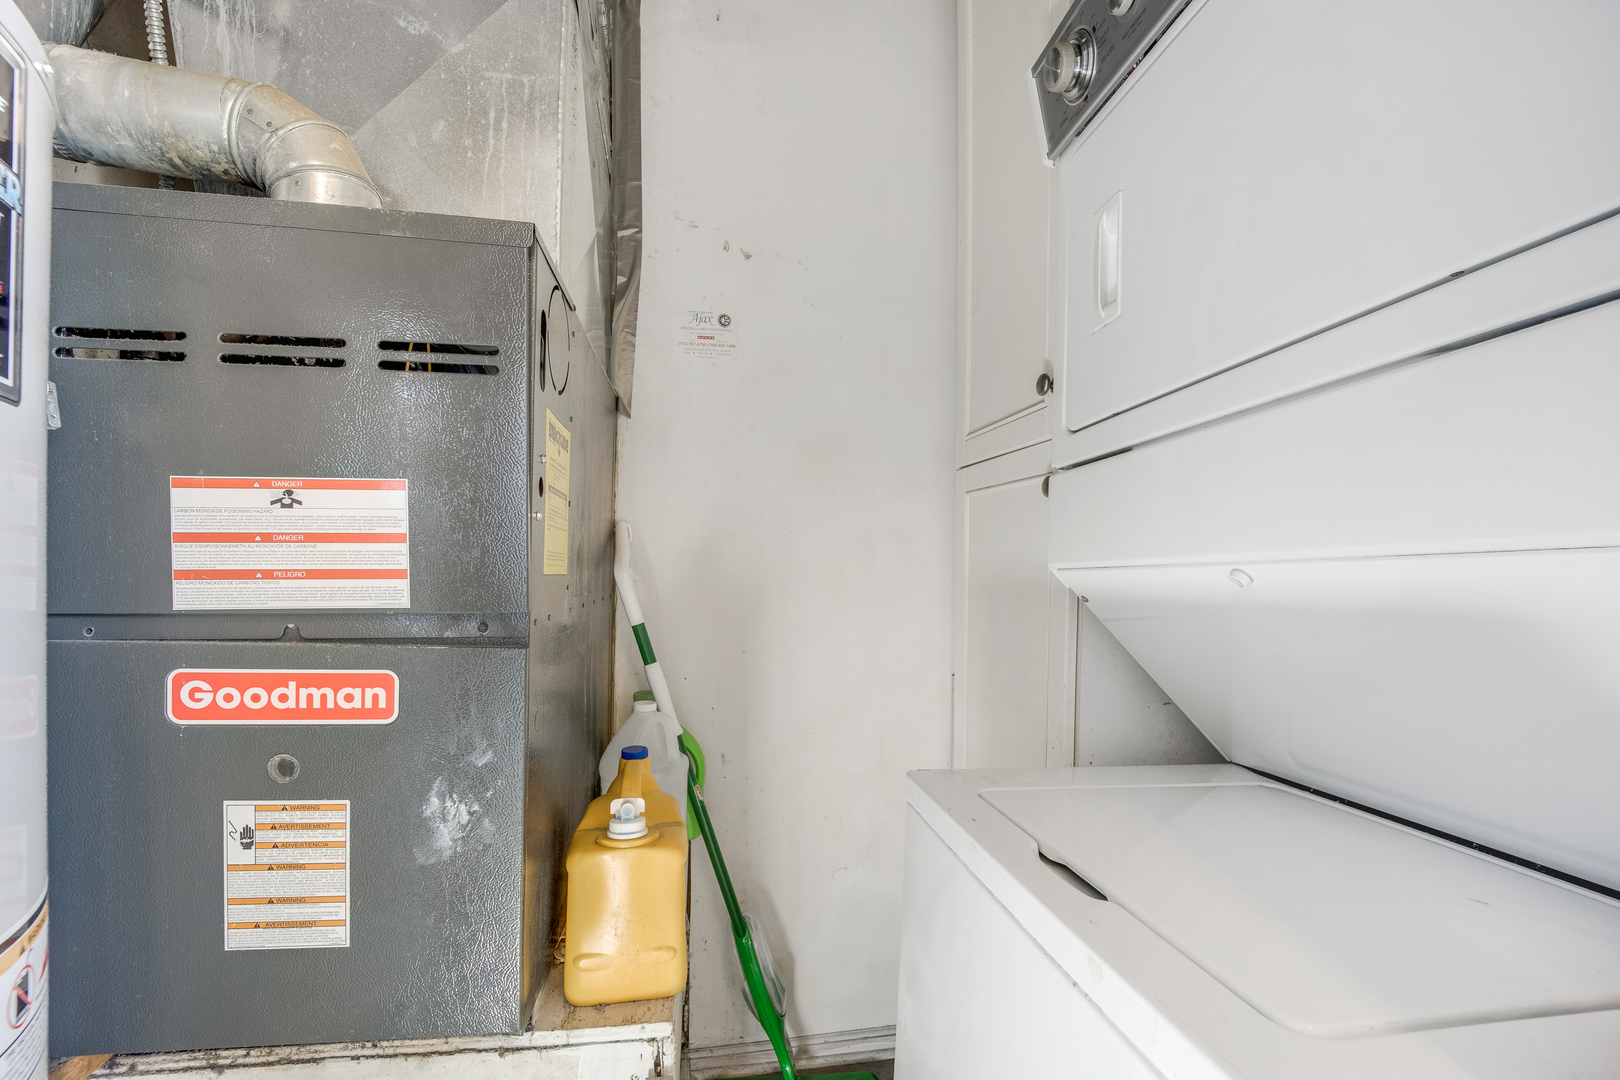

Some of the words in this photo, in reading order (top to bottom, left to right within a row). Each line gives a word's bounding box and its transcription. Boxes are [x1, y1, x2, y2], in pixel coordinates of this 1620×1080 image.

[688, 313, 715, 326] Ajax
[271, 480, 303, 488] DANGER
[179, 680, 387, 710] Goodman
